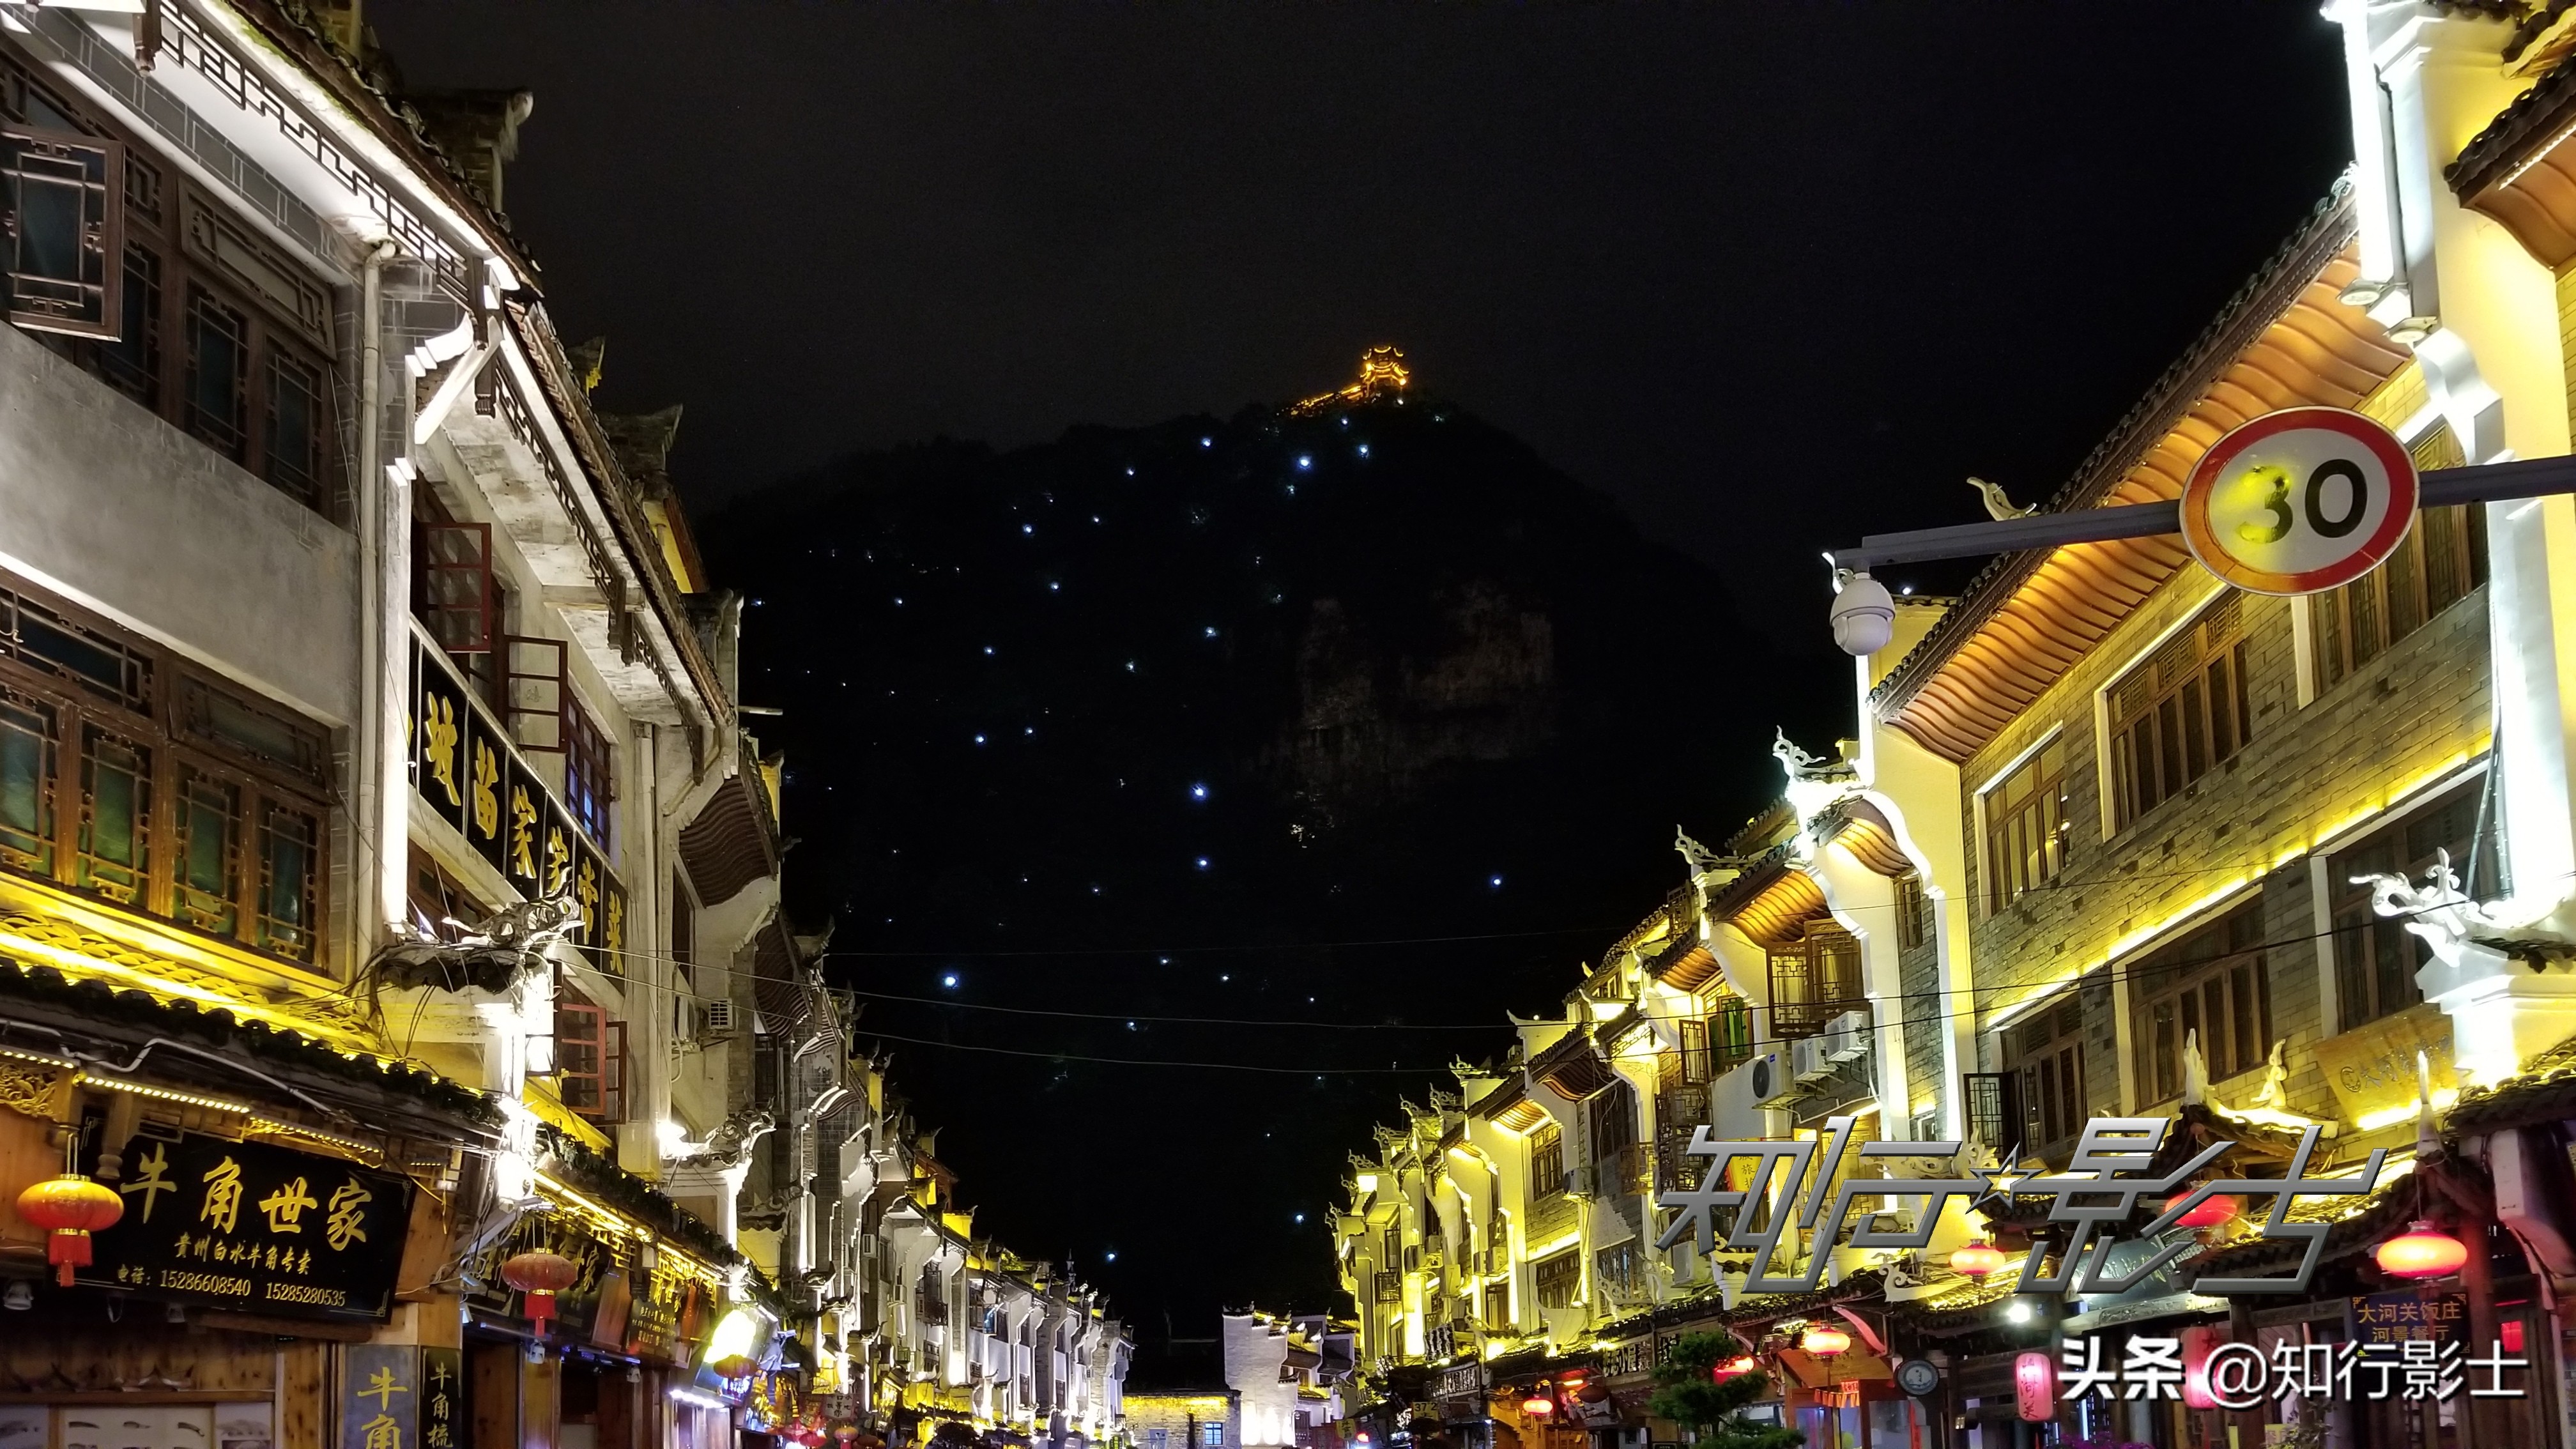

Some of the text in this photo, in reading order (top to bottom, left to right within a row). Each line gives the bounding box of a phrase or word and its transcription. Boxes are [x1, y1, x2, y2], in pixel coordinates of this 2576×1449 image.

[2239, 459, 2368, 543] 30
[120, 1142, 372, 1252] 牛角世家
[160, 1269, 251, 1296] 15286608540
[265, 1282, 346, 1307] 15285280535
[2358, 1301, 2462, 1323] 大河关饭庄
[2372, 1325, 2450, 1342] 河景餐厅
[426, 1361, 453, 1448] 牛角梳
